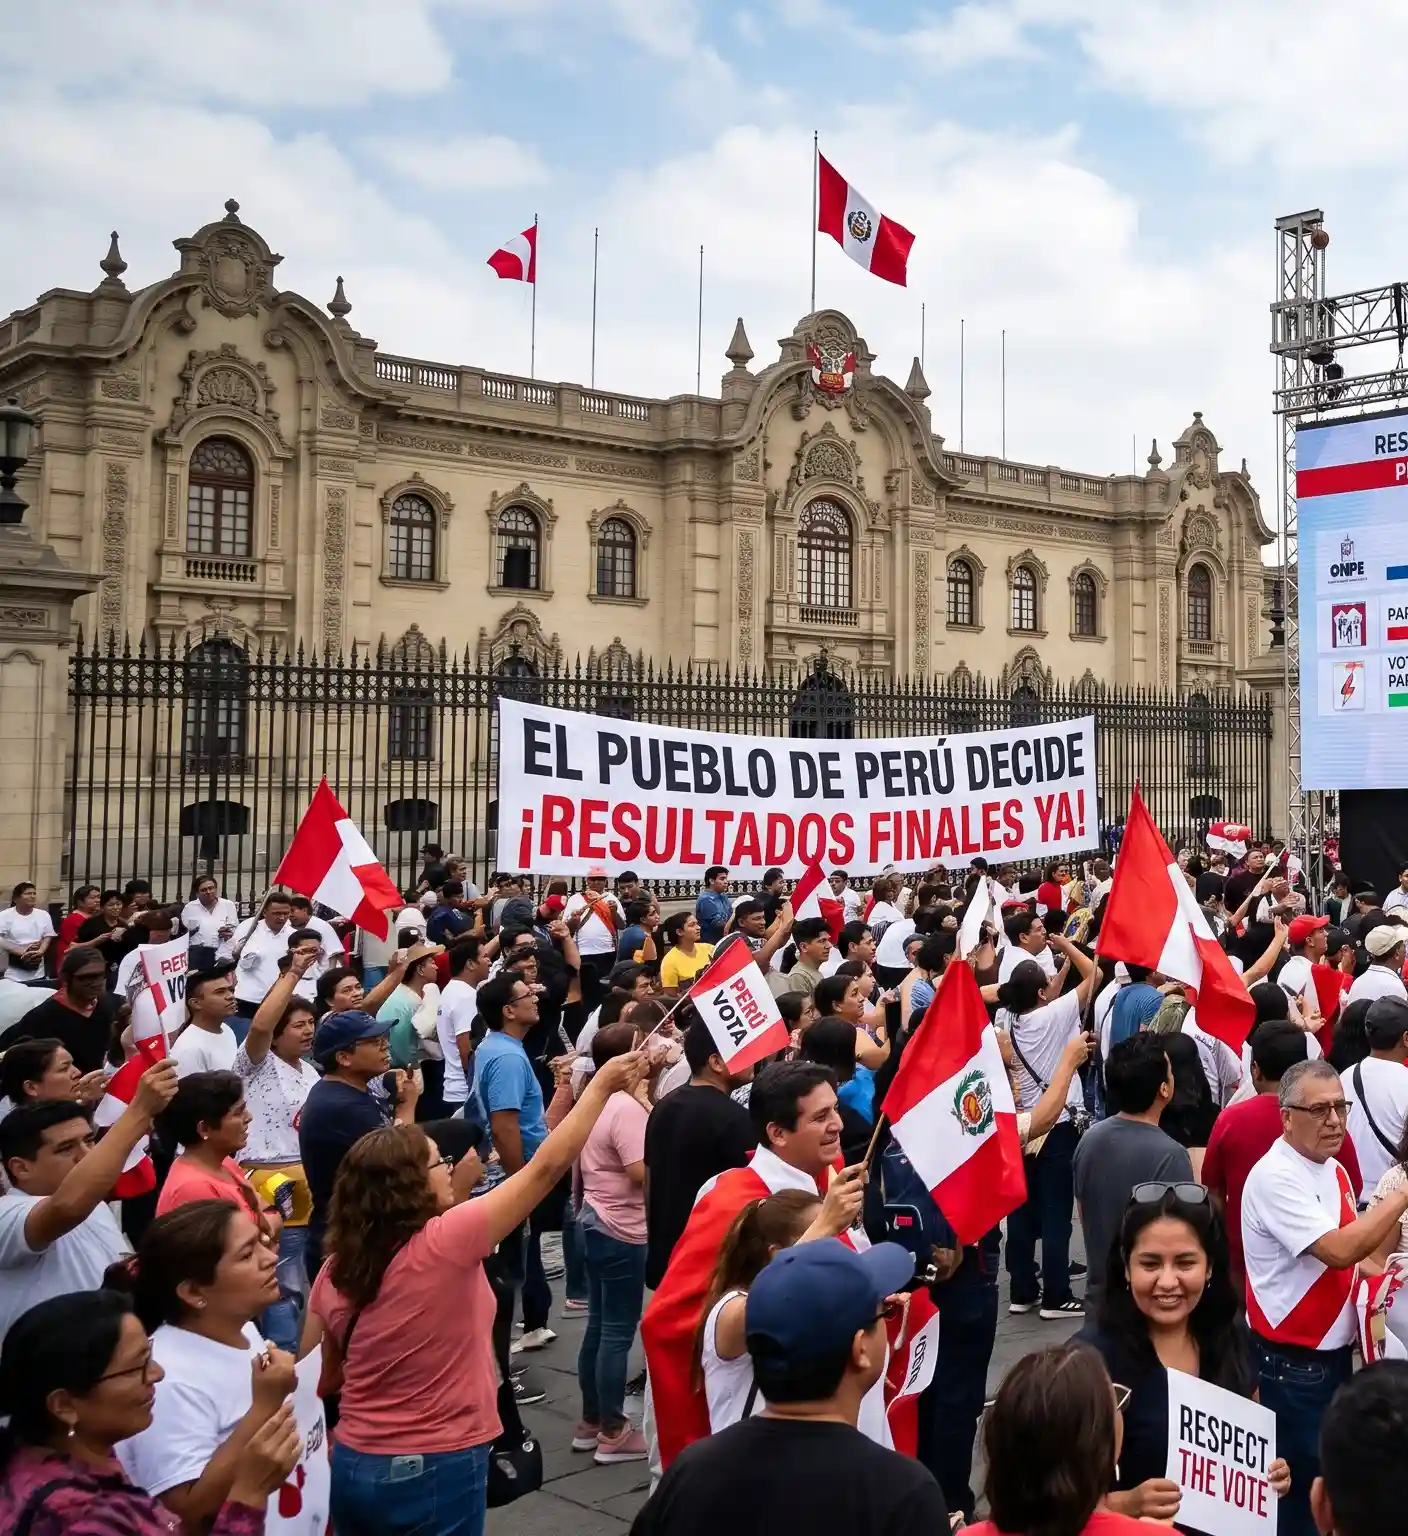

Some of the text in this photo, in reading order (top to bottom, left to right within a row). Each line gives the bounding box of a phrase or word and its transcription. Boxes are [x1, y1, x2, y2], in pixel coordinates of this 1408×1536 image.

[1330, 561, 1364, 578] ONPE
[522, 717, 1085, 799] EL PUEBLO DE PERÚ DECIDE
[519, 788, 1087, 869] ¡RESULTADOS FINALES YA!
[713, 989, 748, 1047] VOTA
[730, 977, 768, 1030] PERÚ
[1179, 1404, 1269, 1474] RESPECT
[1178, 1448, 1269, 1519] THE VOTE
